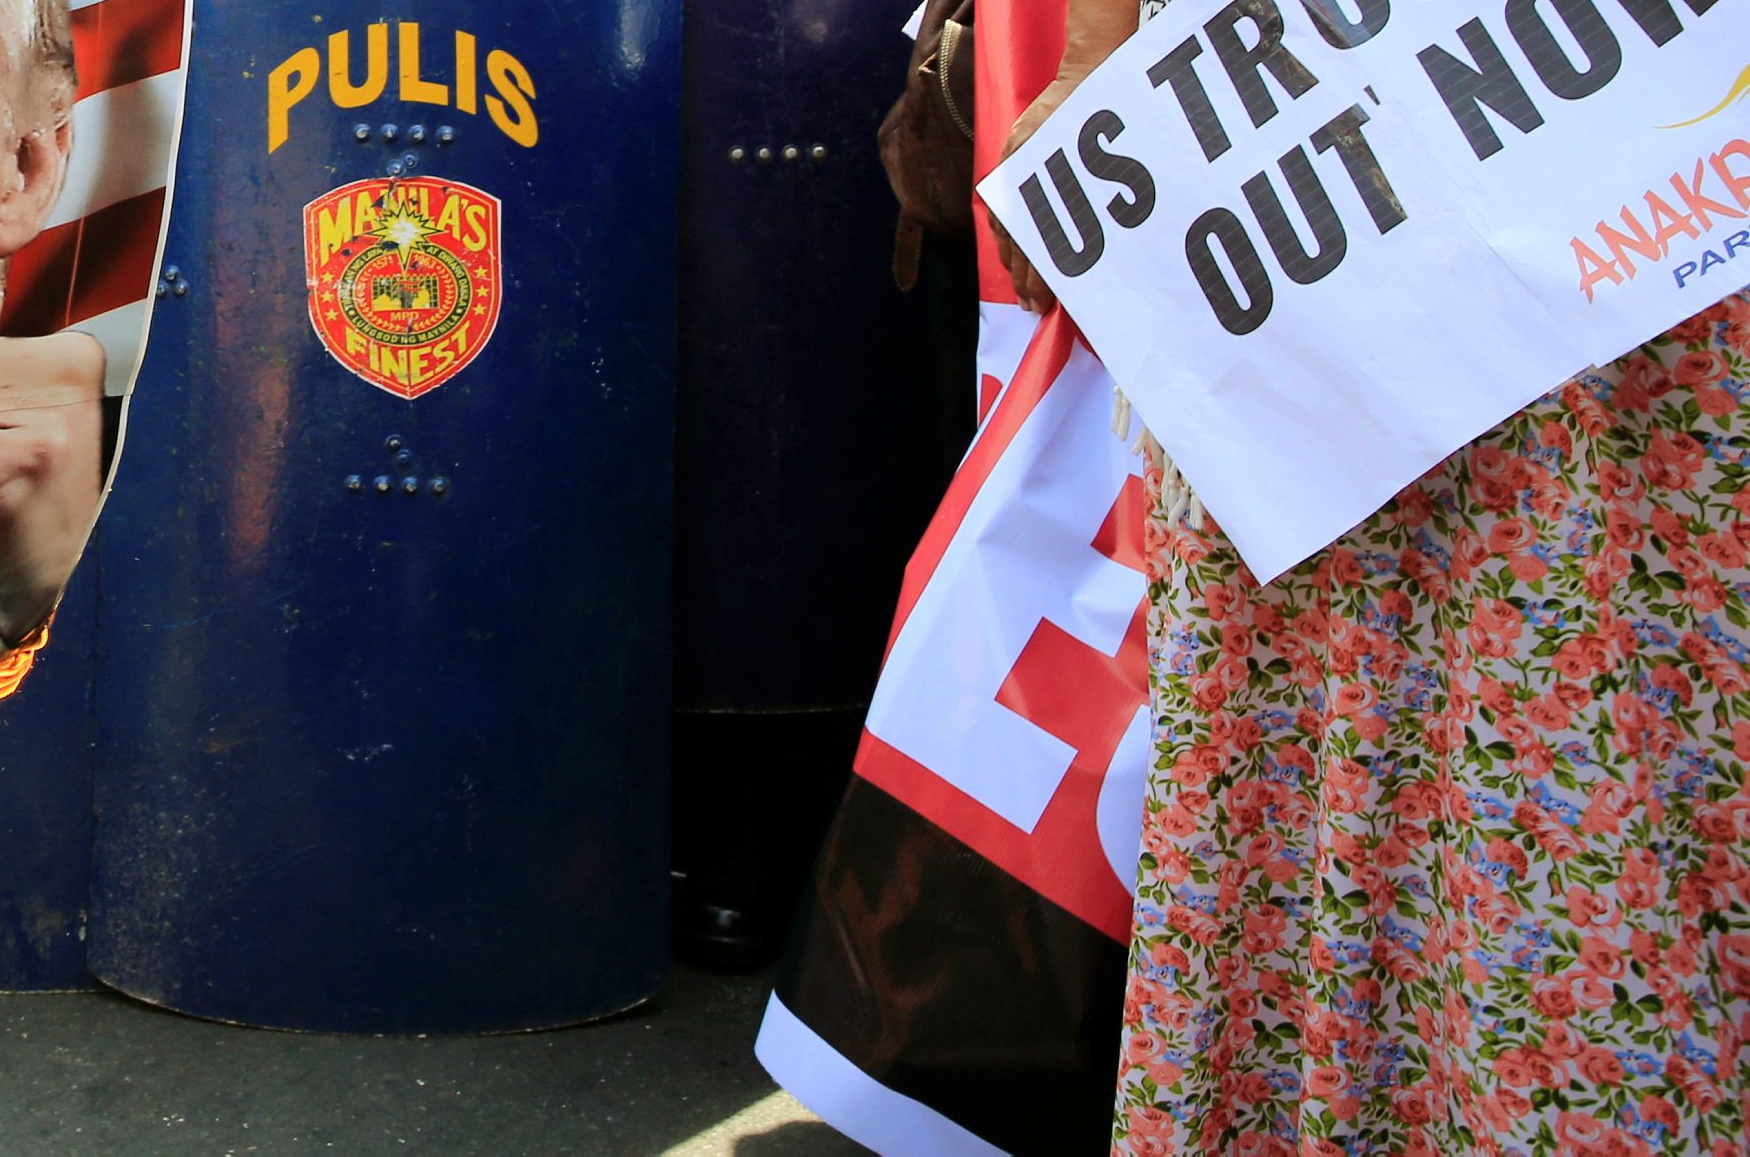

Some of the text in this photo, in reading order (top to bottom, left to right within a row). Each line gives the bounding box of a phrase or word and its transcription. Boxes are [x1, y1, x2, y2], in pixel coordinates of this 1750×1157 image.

[268, 22, 539, 153] PULIS
[1019, 109, 1156, 277] US
[1185, 86, 1408, 336] OUT
[345, 321, 471, 387] FINEST
[351, 315, 398, 343] LUNGSOD
[418, 314, 460, 342] MAYNILA
[390, 311, 419, 321] MPD
